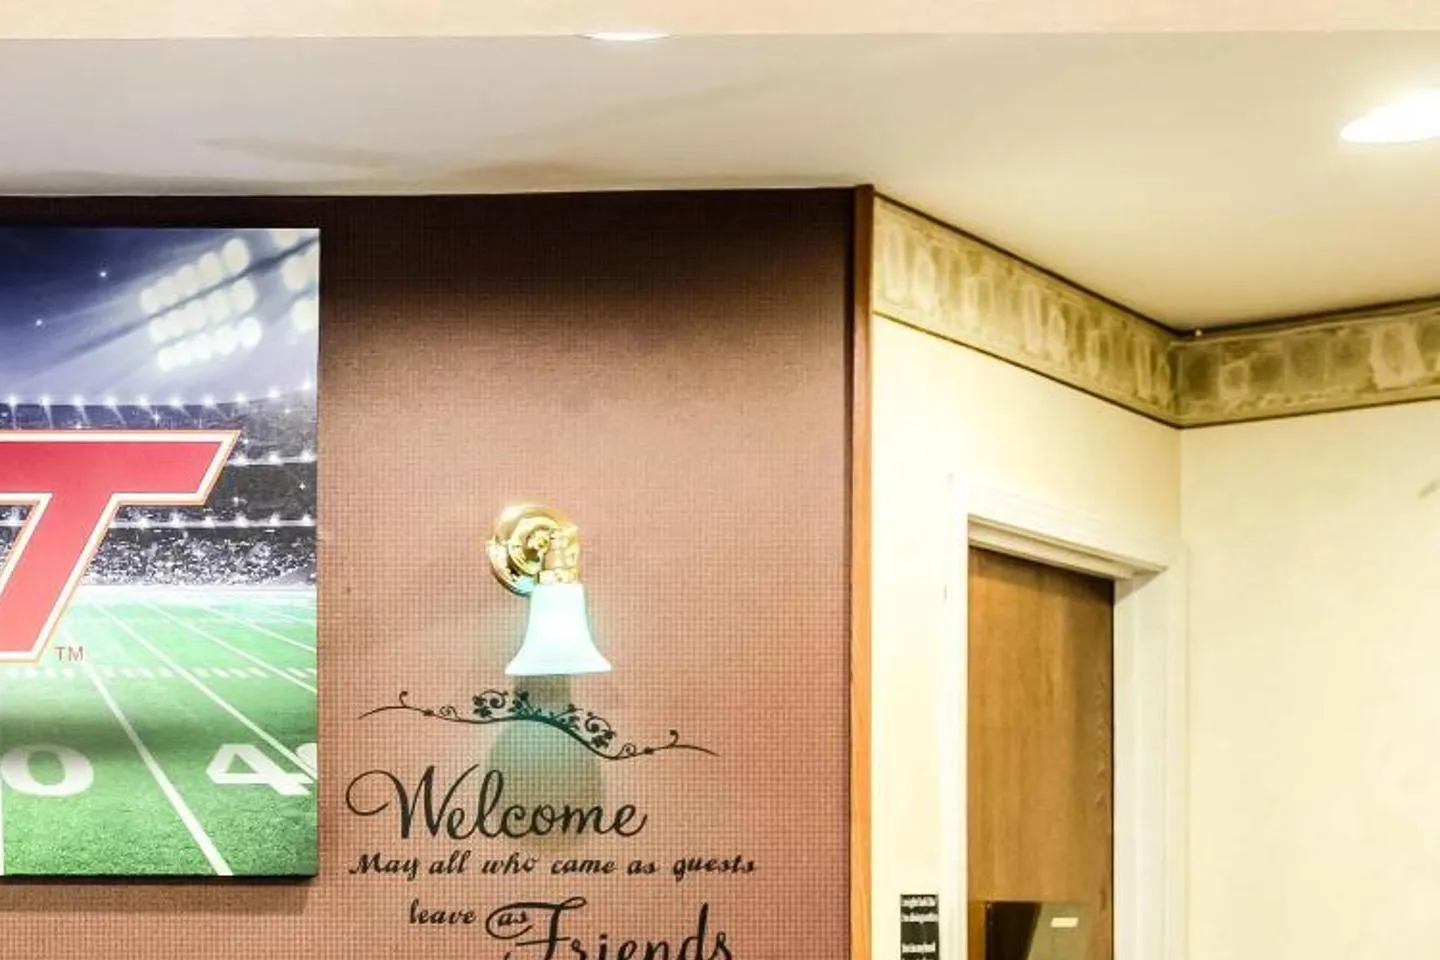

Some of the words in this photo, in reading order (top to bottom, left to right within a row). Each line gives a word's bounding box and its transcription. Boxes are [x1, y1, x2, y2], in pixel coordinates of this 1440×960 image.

[54, 645, 85, 662] TM
[205, 742, 318, 796] 4
[345, 764, 647, 839] Welcome
[349, 851, 418, 881] May
[428, 850, 471, 875] all
[481, 852, 538, 875] who
[550, 858, 616, 875] came
[627, 859, 657, 875] as
[672, 854, 755, 882] guests
[409, 898, 476, 925] leave
[496, 910, 528, 927] as
